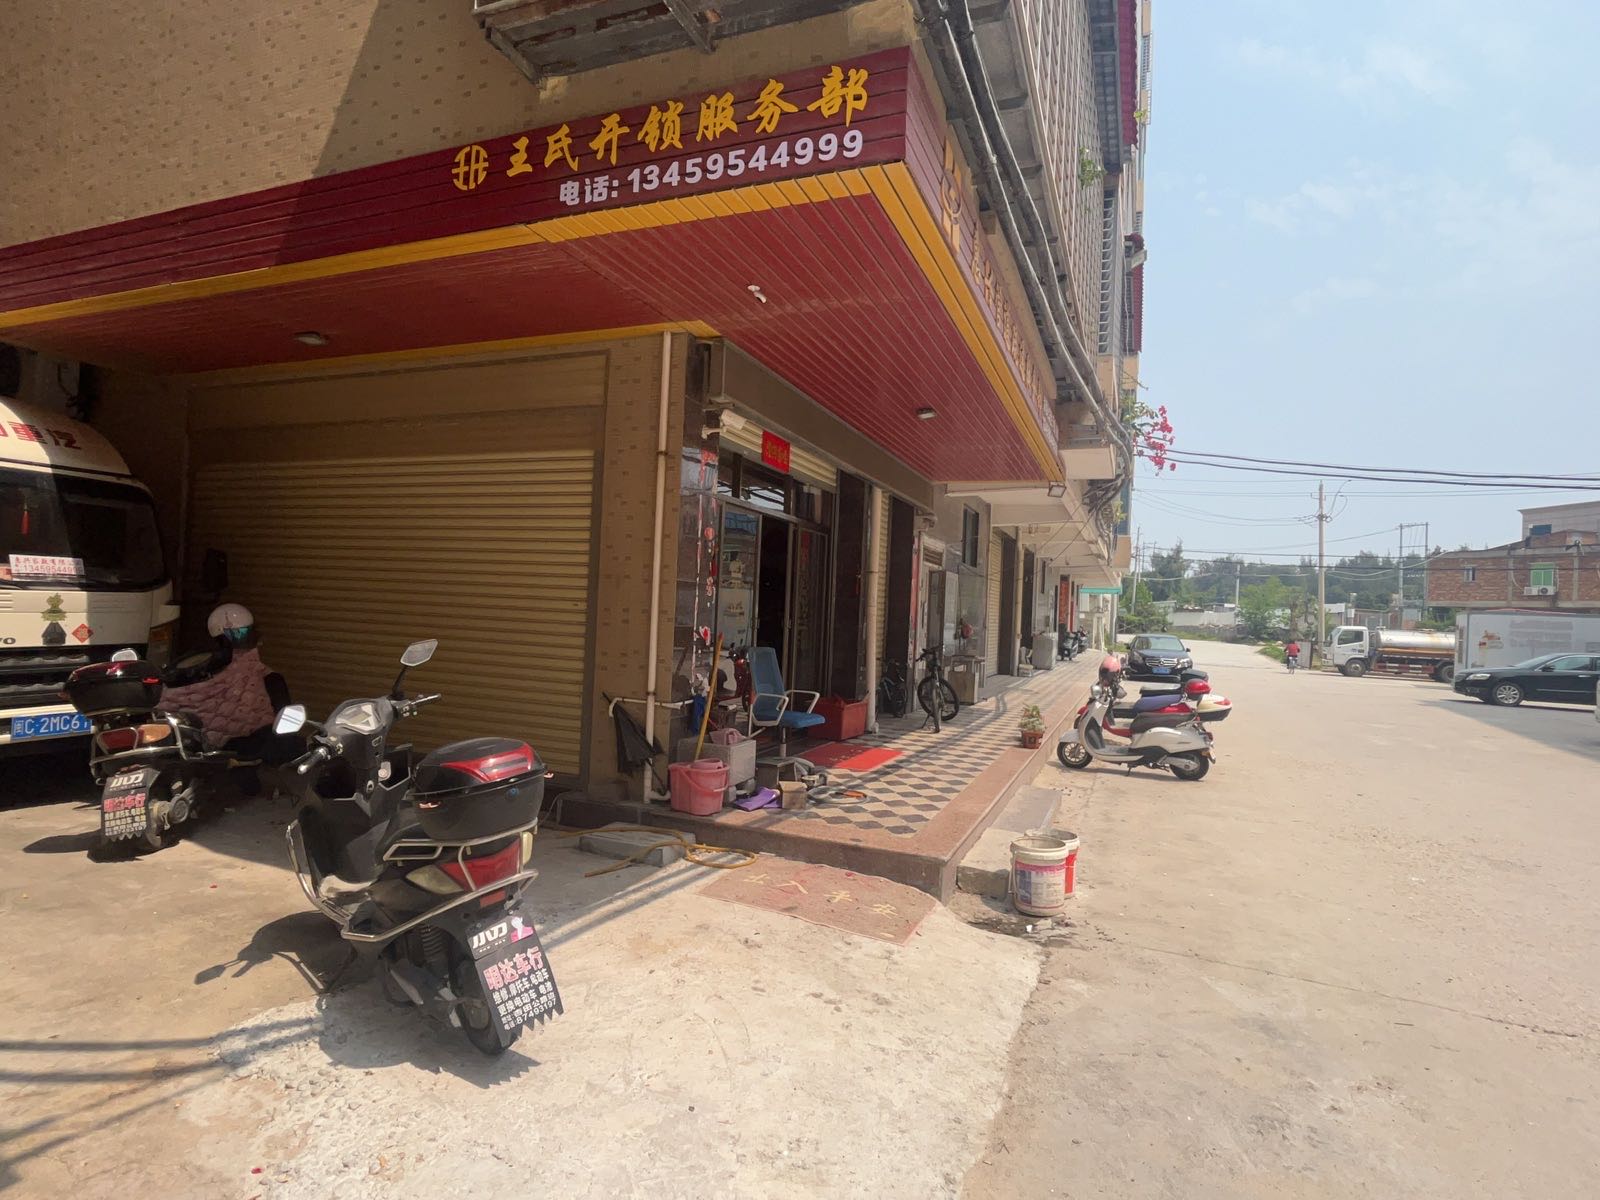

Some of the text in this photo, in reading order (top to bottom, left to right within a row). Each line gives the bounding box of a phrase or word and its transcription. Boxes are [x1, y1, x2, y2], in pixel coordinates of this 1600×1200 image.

[506, 65, 869, 178] 王氏开锁服务部
[0, 420, 81, 450] 重汽
[14, 714, 88, 735] 闽C·2MC6
[483, 946, 543, 990] 明达车行
